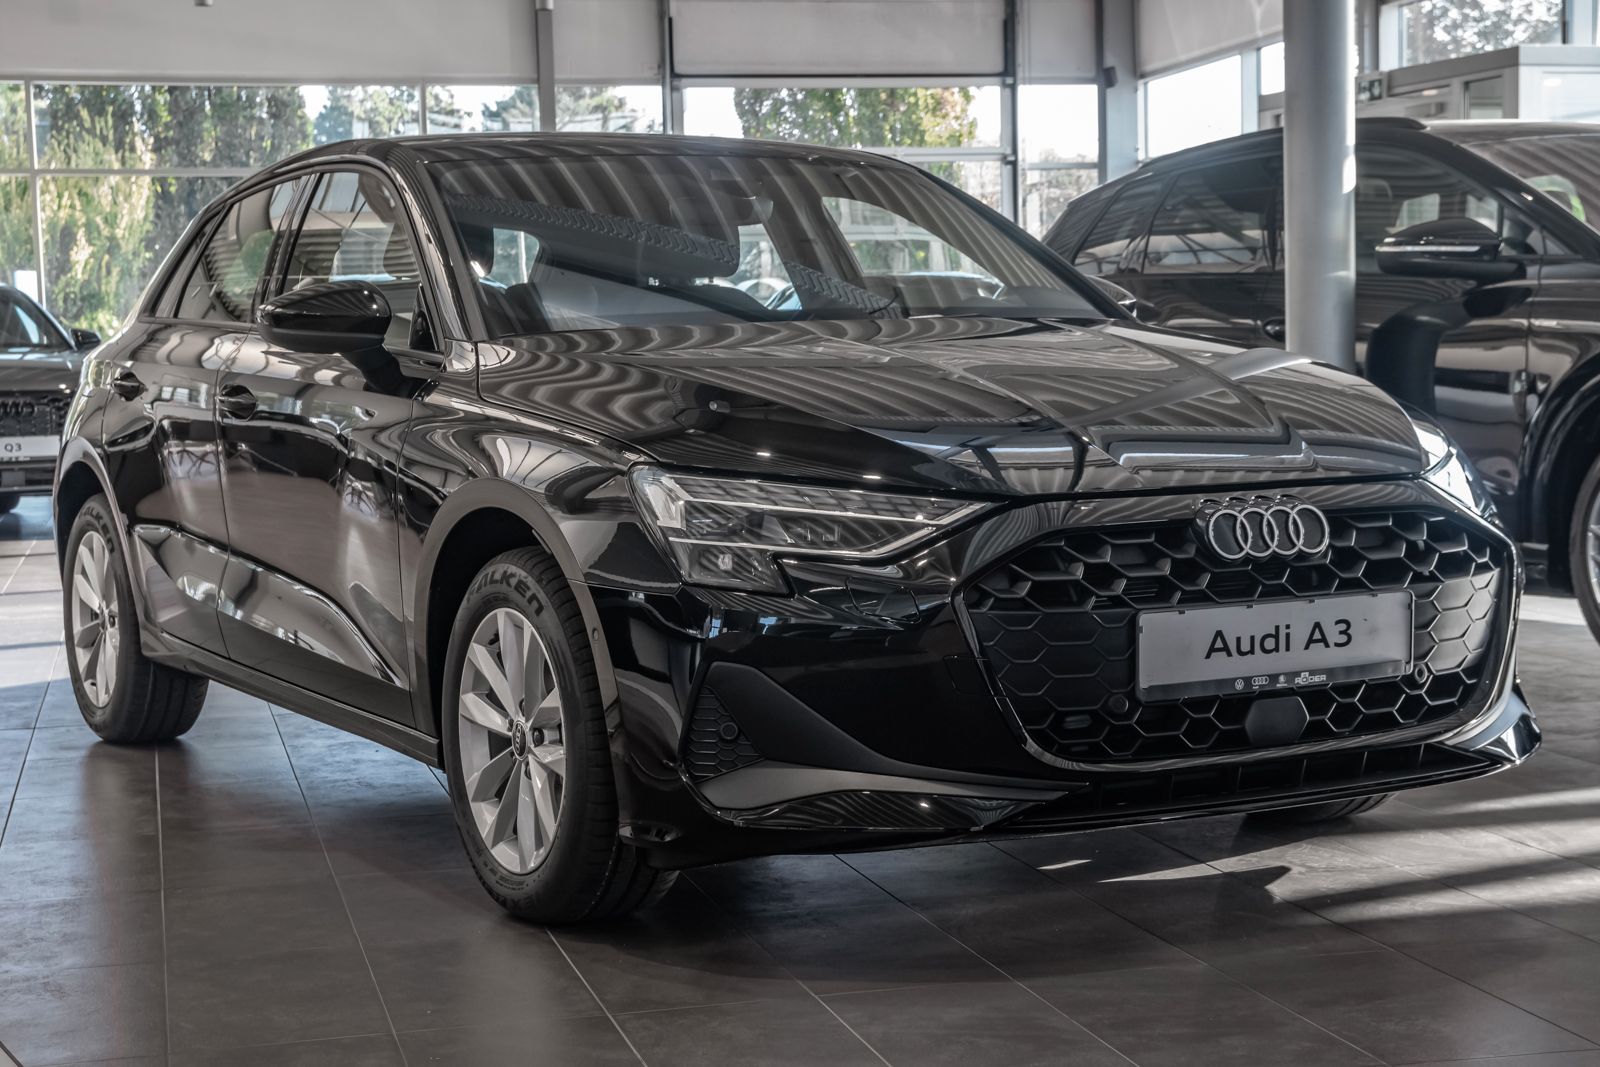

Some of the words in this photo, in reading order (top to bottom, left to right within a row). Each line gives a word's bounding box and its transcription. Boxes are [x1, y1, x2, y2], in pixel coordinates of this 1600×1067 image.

[4, 443, 22, 453] Q3
[1204, 624, 1291, 660] Audi
[1303, 618, 1353, 651] A3
